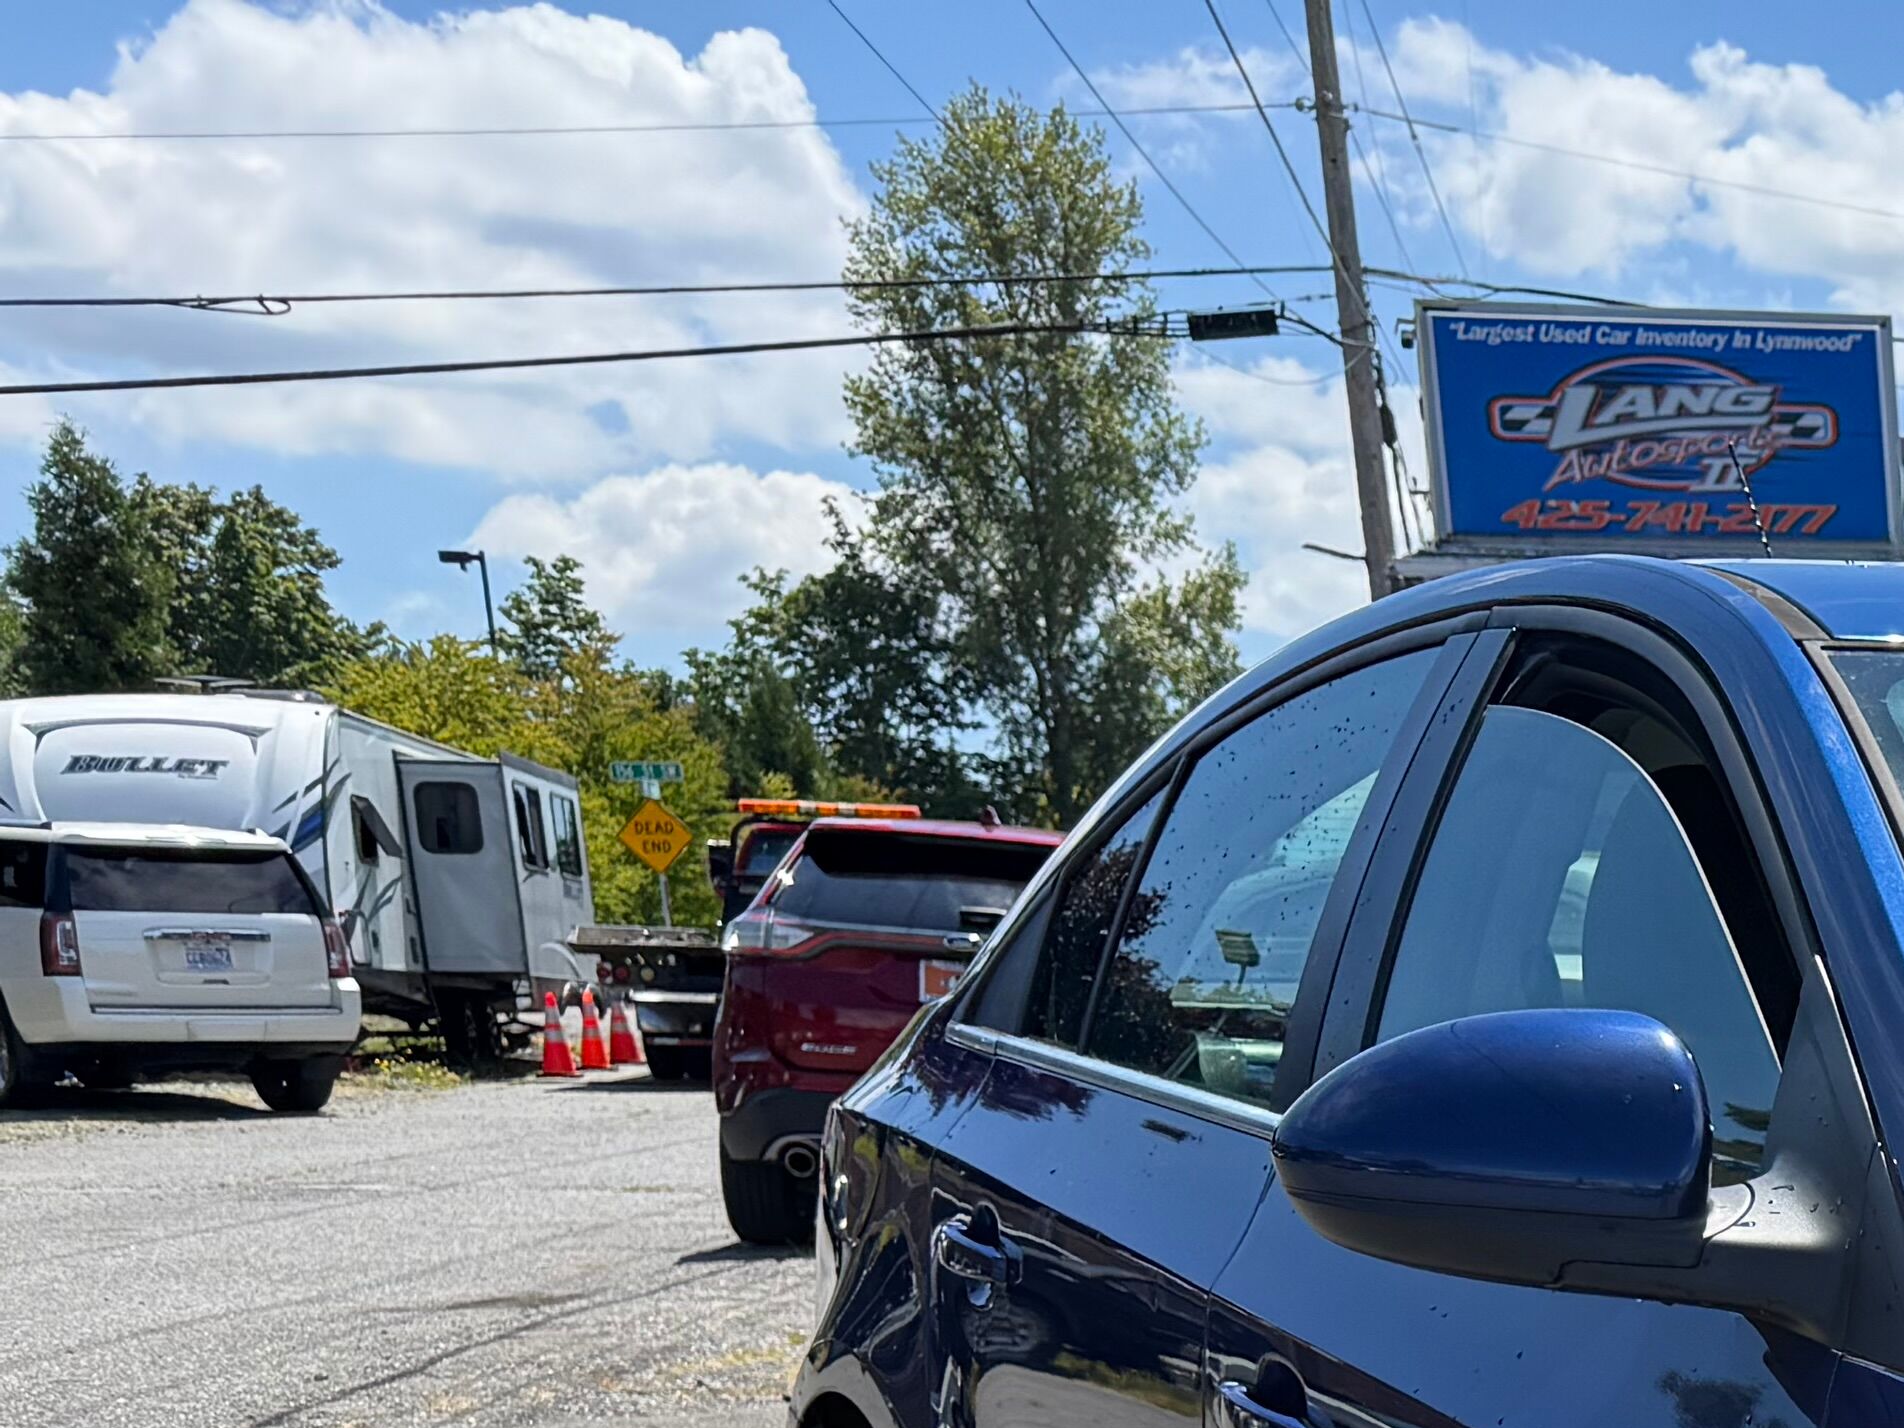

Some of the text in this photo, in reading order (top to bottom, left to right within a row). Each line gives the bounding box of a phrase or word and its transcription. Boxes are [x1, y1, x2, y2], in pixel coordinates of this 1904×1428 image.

[1539, 323, 1592, 344] Used
[1596, 325, 1632, 346] Car
[1635, 327, 1729, 352] Inventory
[1732, 330, 1752, 348] In
[1549, 384, 1776, 449] LANG
[59, 754, 230, 775] BULLET
[634, 820, 674, 835] DEAD
[643, 840, 672, 854] END
